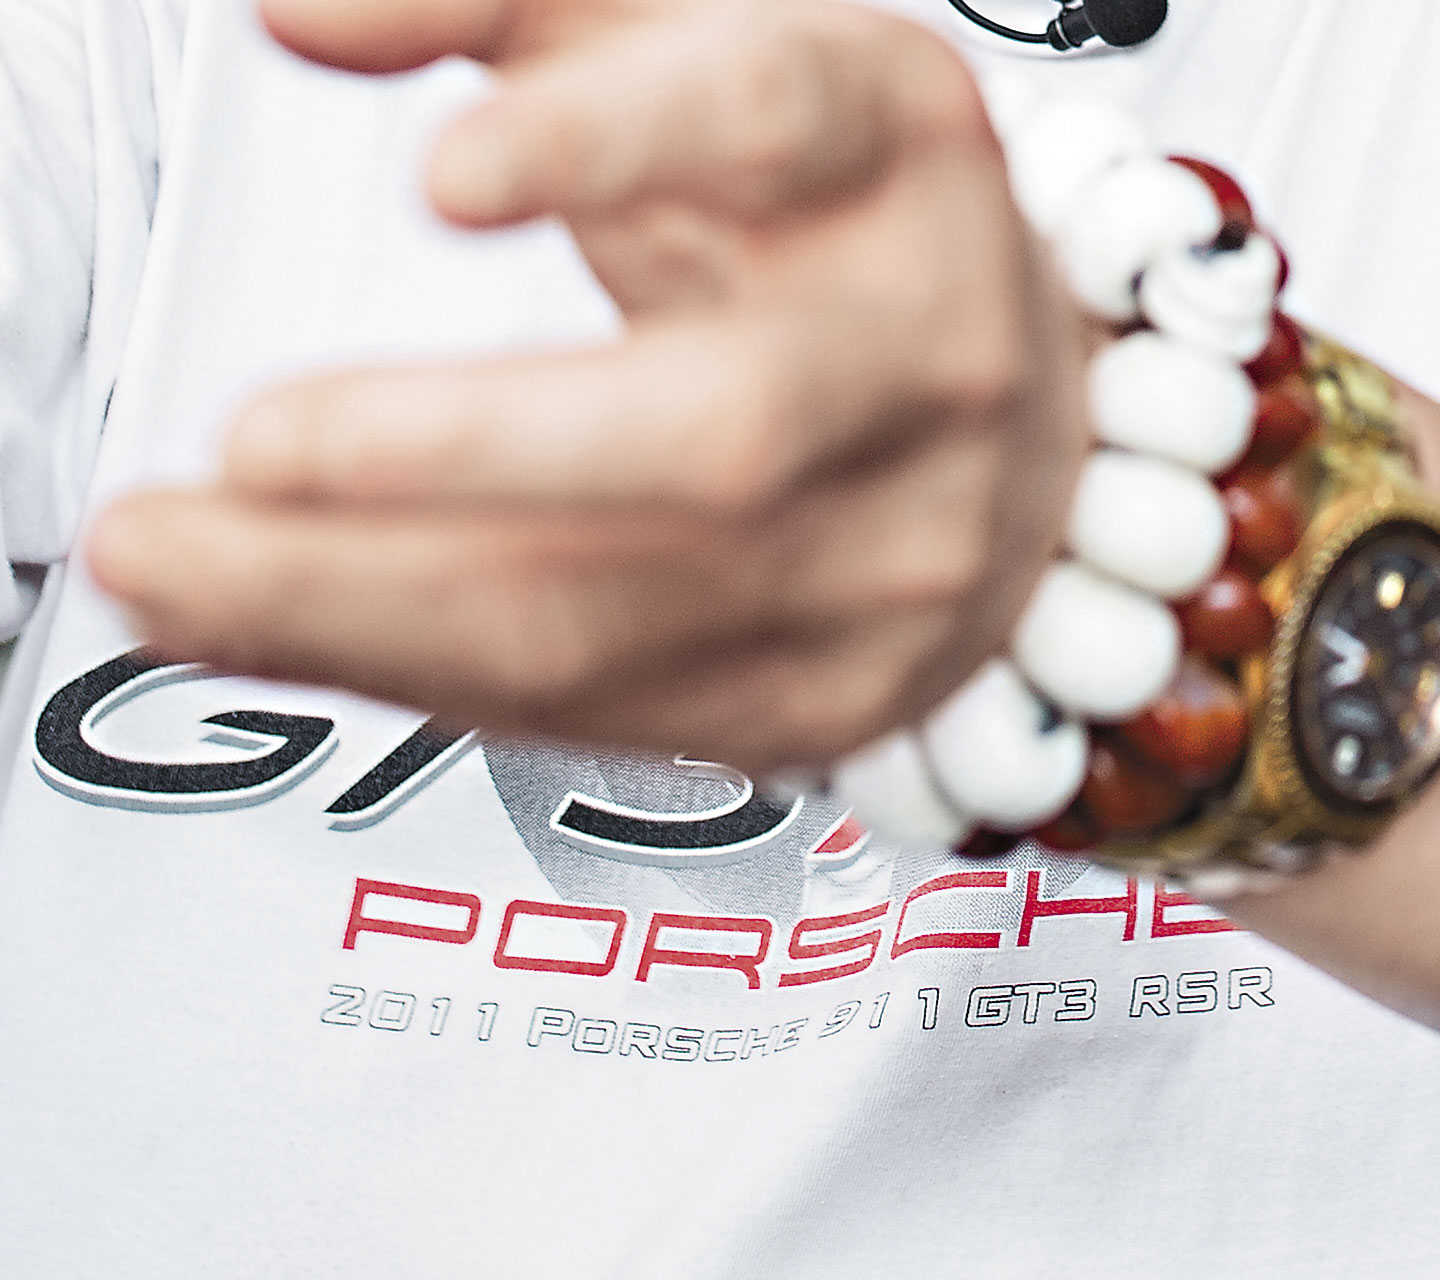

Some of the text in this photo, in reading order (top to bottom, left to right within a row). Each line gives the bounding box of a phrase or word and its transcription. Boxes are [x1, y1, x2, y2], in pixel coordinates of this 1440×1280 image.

[343, 868, 1244, 992] PORSCHE
[320, 982, 500, 1044] 2011
[964, 977, 1098, 1030] GT3
[1129, 965, 1275, 1020] RSR
